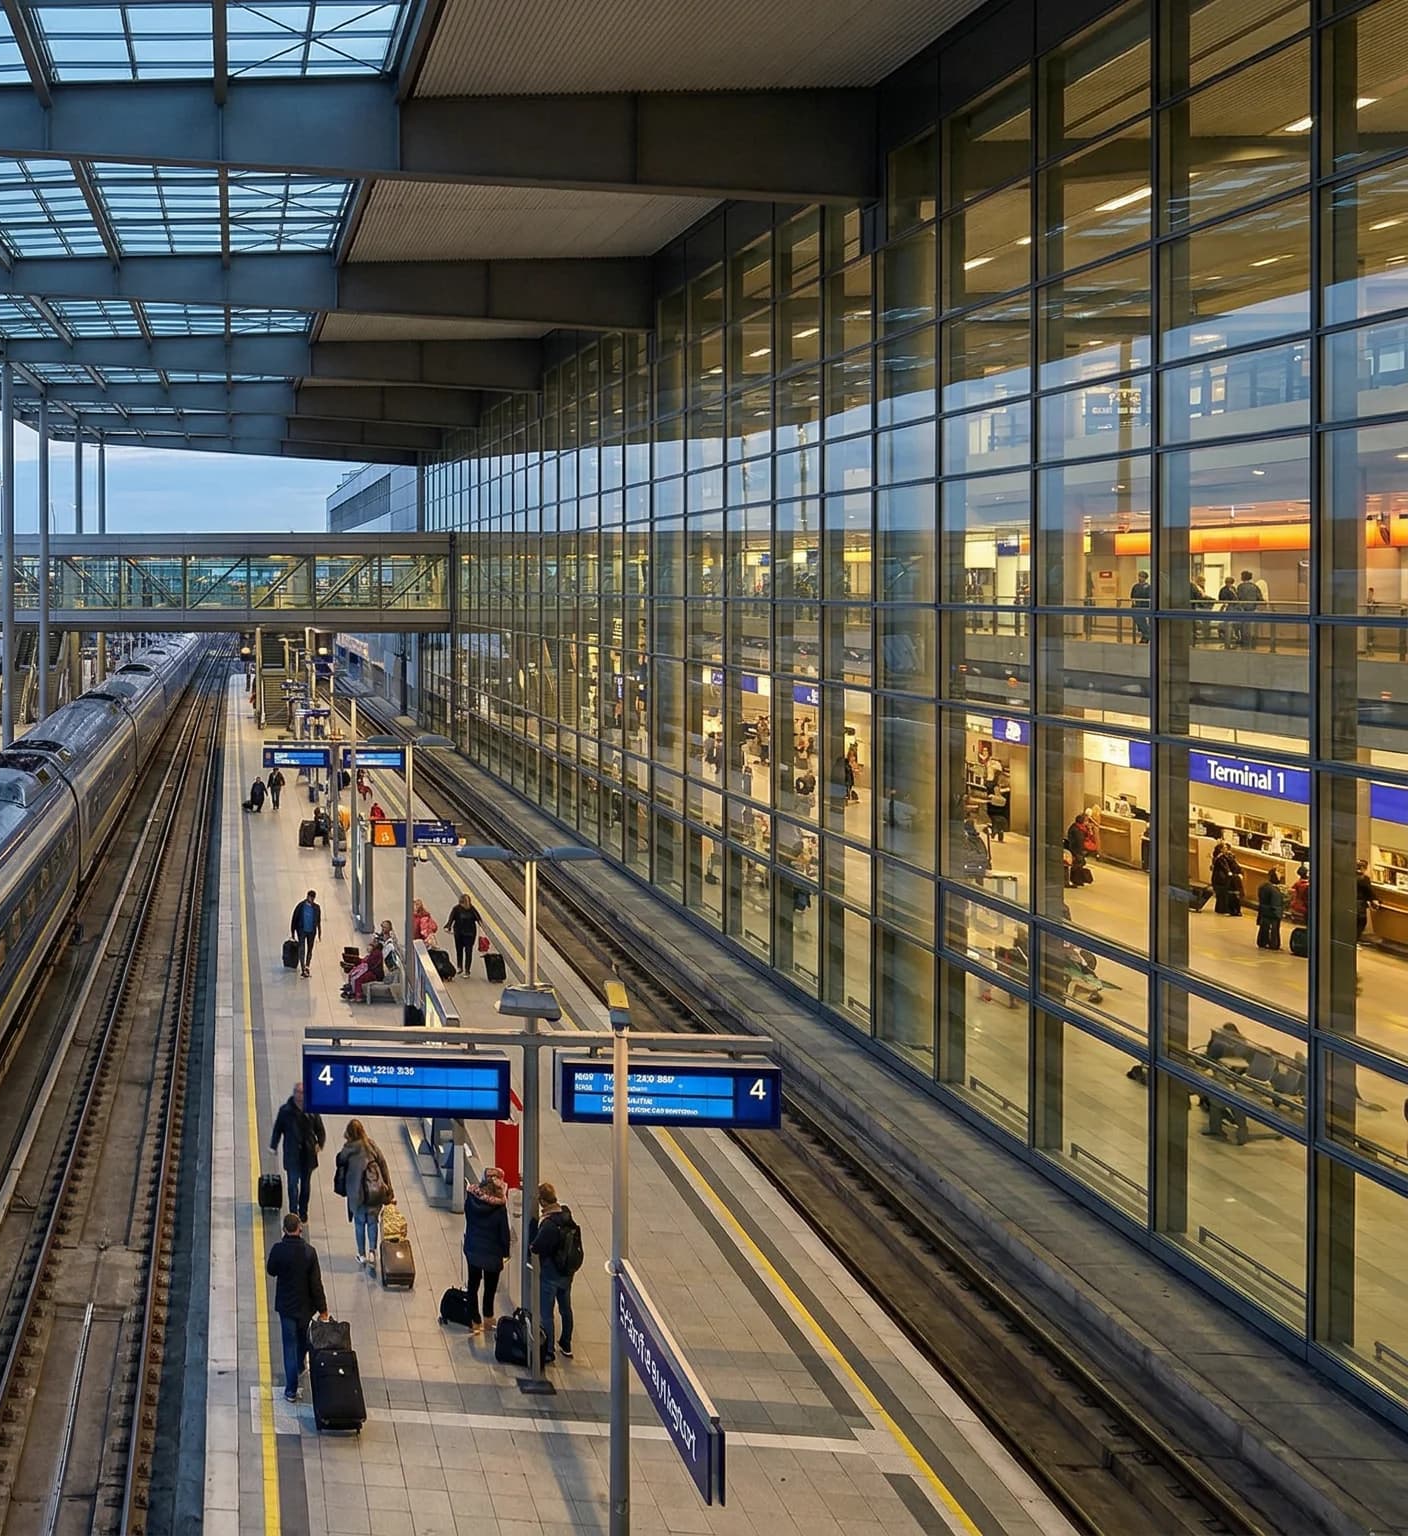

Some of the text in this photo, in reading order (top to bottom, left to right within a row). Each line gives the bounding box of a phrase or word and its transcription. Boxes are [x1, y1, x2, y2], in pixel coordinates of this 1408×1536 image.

[1207, 759, 1285, 793] Terminal 1
[318, 1064, 334, 1086] 4
[749, 1078, 767, 1100] 4
